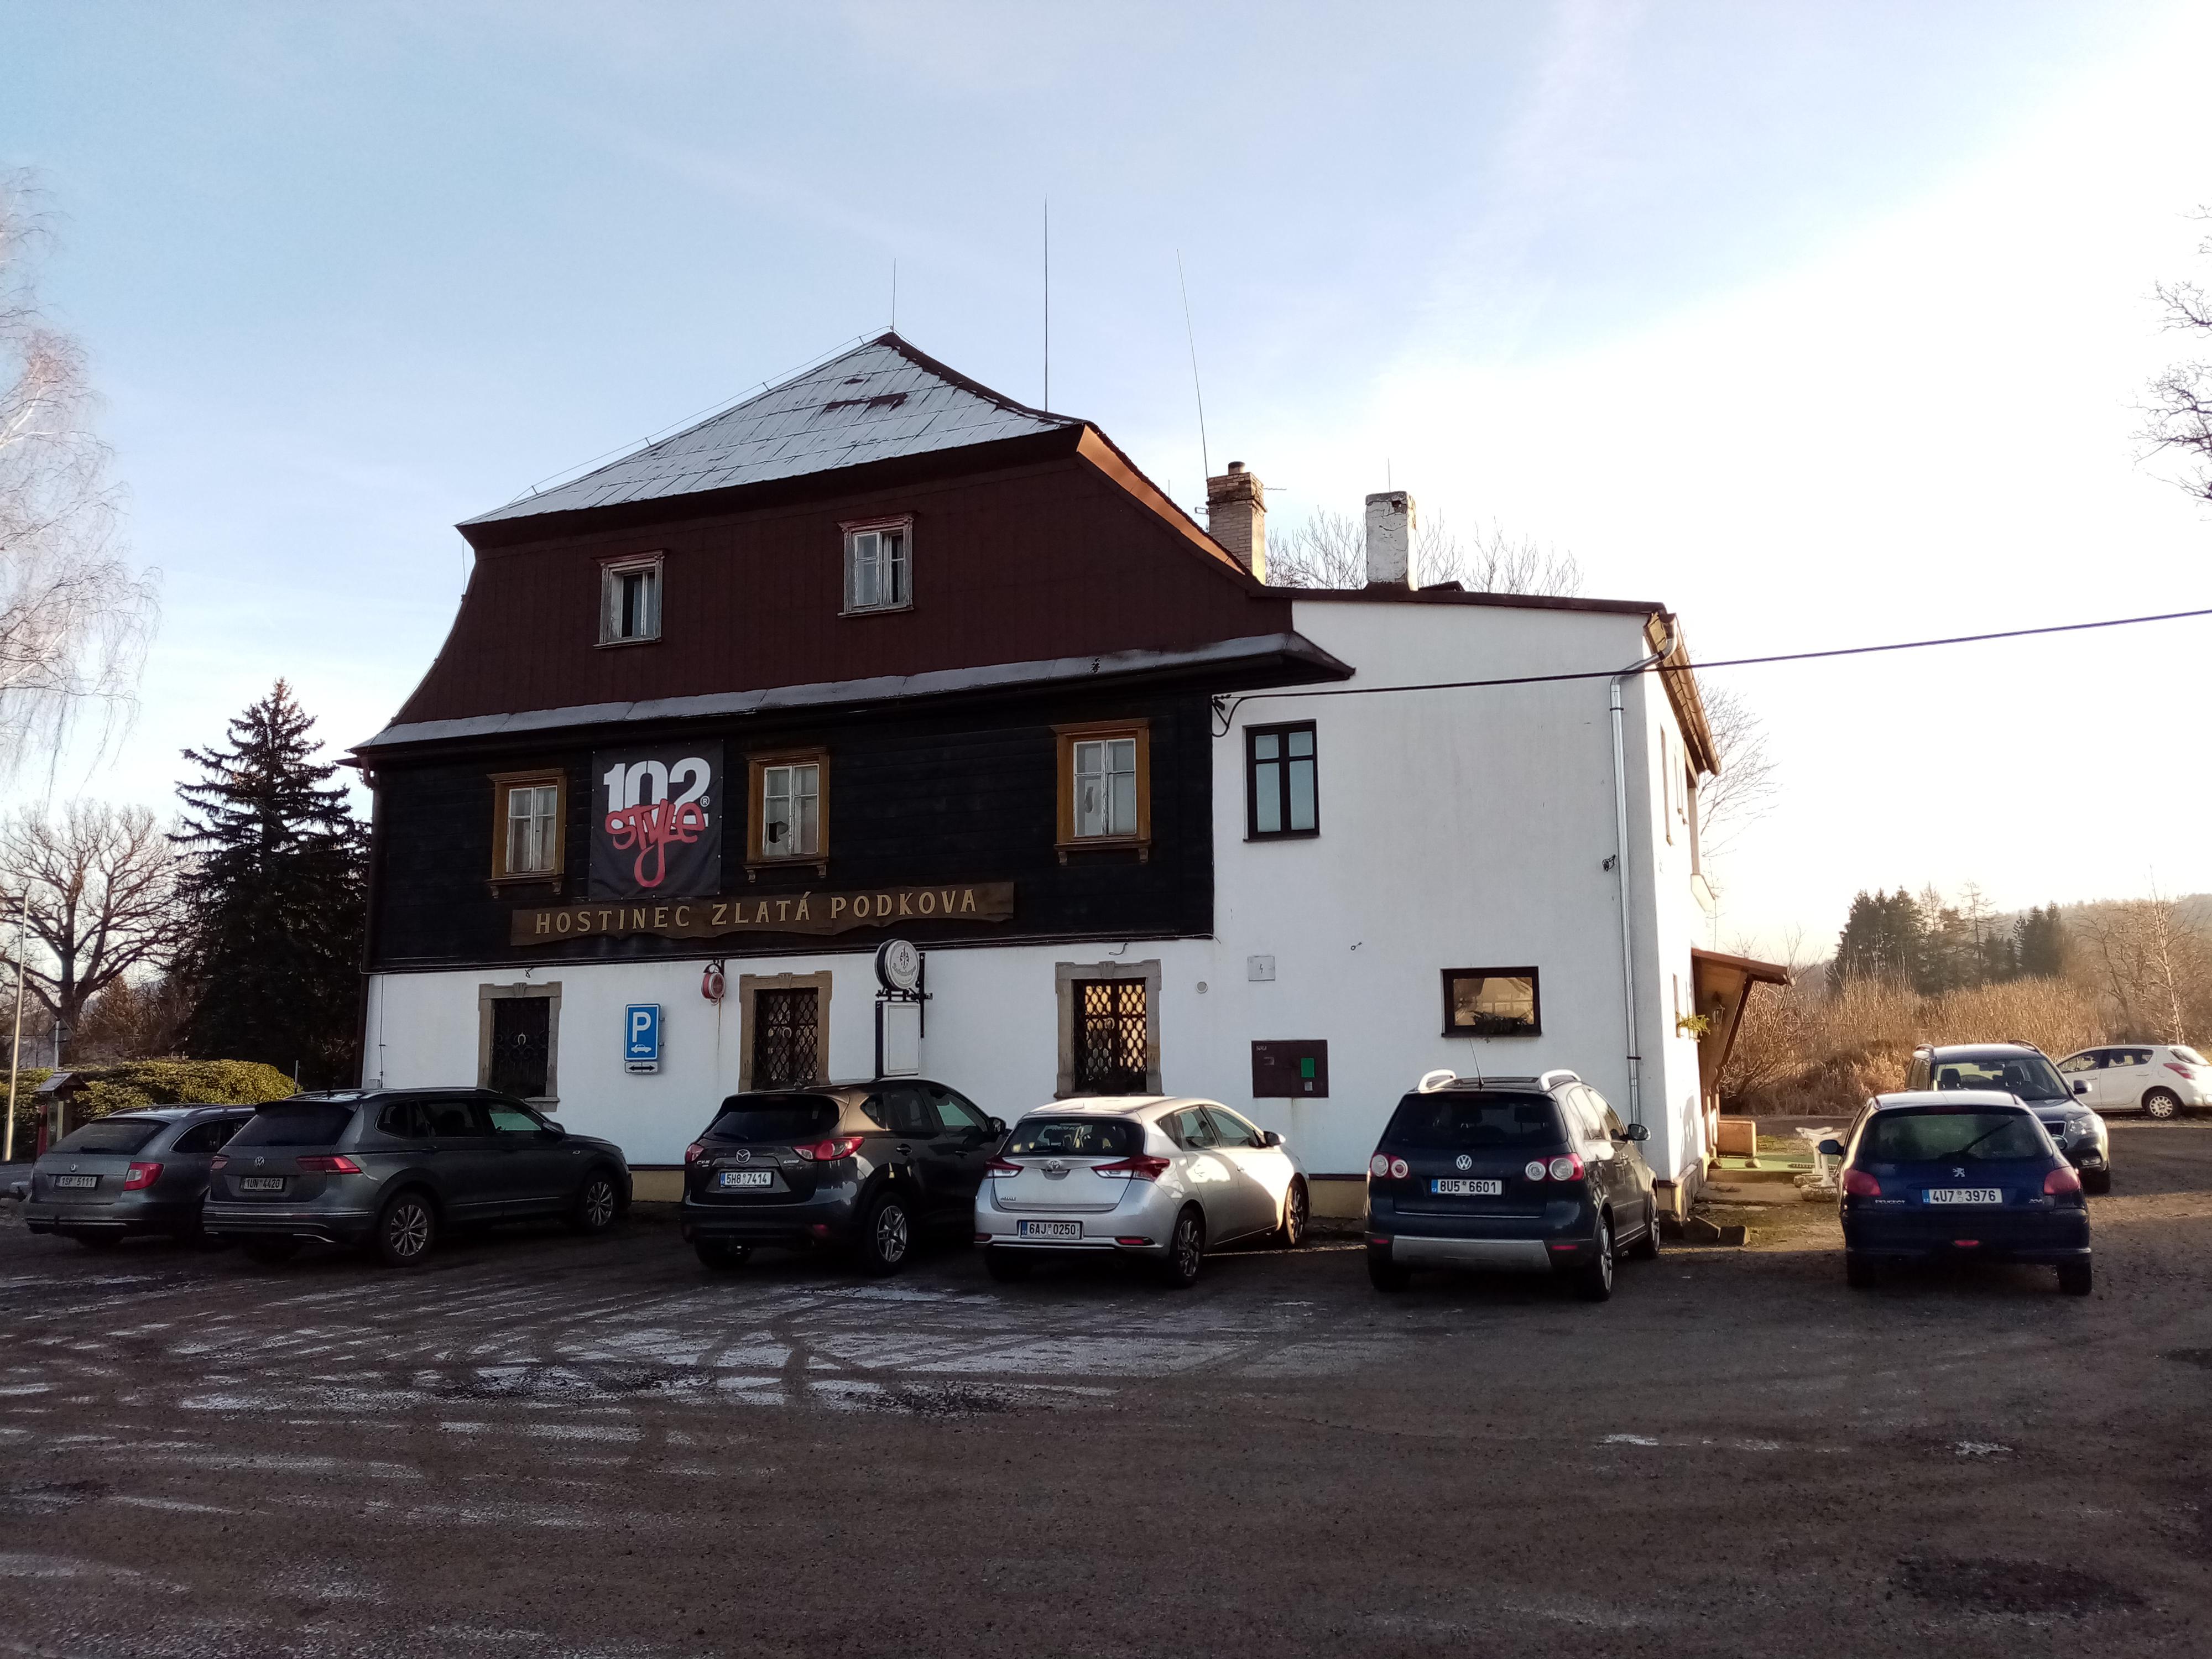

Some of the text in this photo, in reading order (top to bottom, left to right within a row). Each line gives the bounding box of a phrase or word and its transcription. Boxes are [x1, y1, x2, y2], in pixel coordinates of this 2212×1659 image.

[603, 757, 711, 828] 102
[535, 889, 977, 934] HOSTINEC ZLATÁ PODKOVA
[632, 1011, 651, 1042] P
[77, 1177, 93, 1186] 5111
[726, 1173, 767, 1184] 5H8 7414
[1440, 1181, 1496, 1193] 8U5 6601
[1932, 1190, 1954, 1203] 4U7
[1964, 1190, 1996, 1202] 3976
[1029, 1223, 1076, 1235] 6AJ 0250
